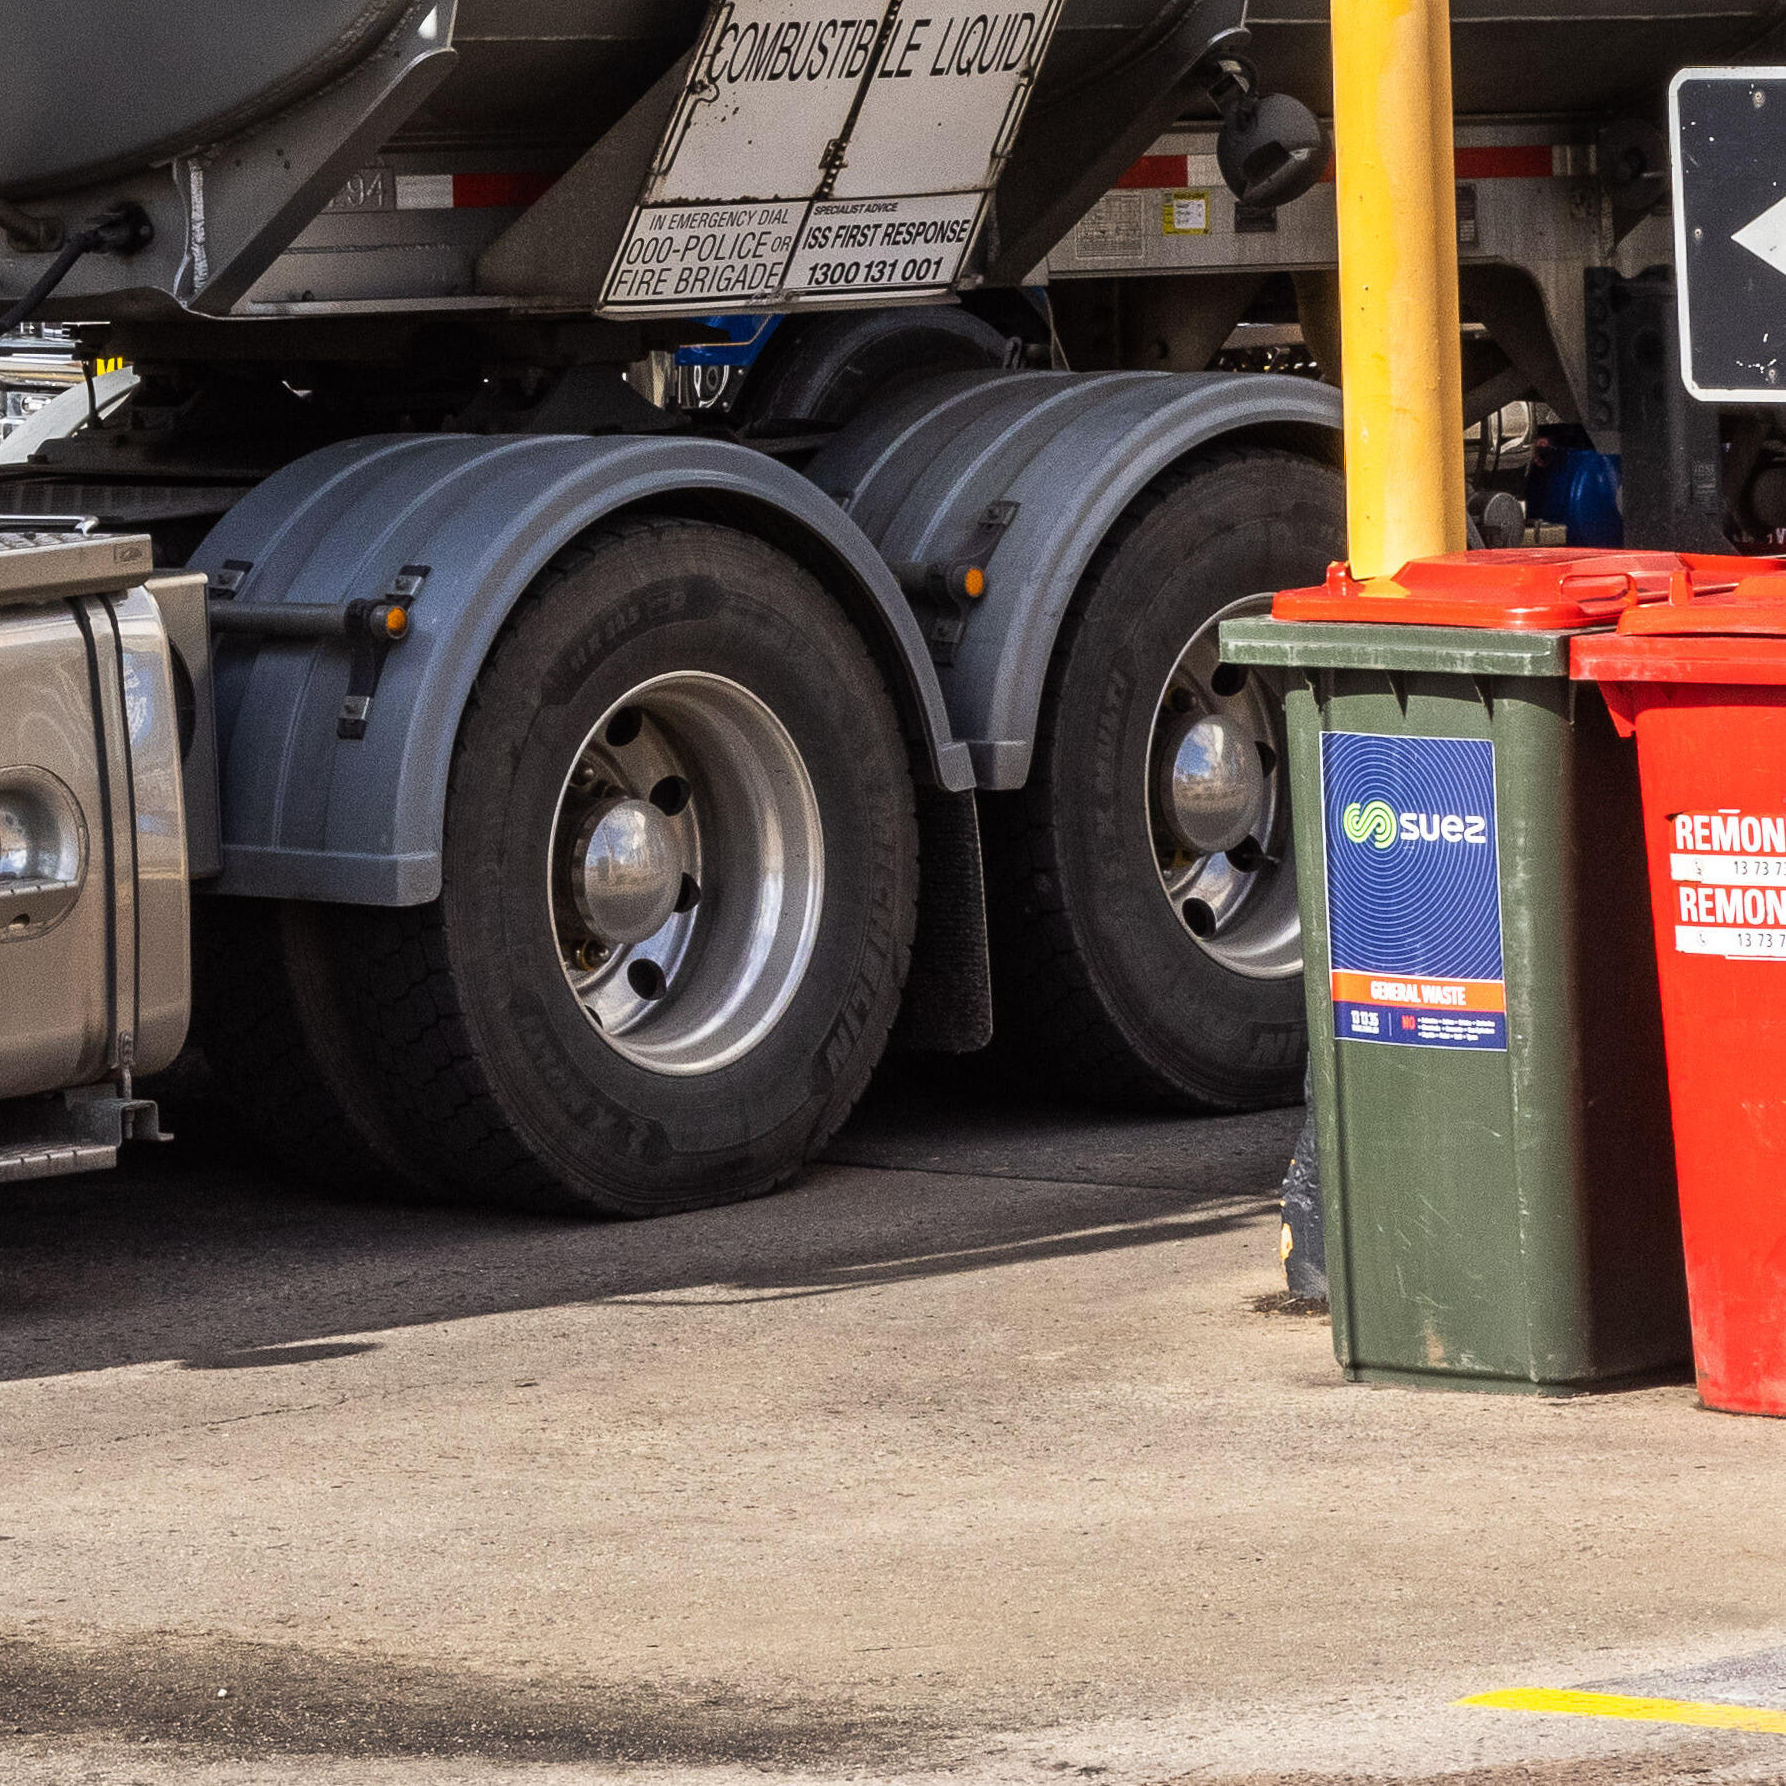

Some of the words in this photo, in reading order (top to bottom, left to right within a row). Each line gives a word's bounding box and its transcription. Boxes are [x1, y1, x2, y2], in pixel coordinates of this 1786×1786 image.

[706, 19, 933, 84] COMBUSTIBLE
[929, 13, 1037, 77] LIQUID
[650, 214, 666, 231] IN
[668, 211, 757, 230] EMERGENCY
[758, 208, 788, 226] DIAL
[814, 204, 866, 215] SPECIALIST
[866, 202, 898, 213] ADVICE
[626, 231, 772, 265] 000-POLICE
[771, 236, 792, 253] OR
[803, 227, 831, 250] ISS
[832, 224, 881, 248] FIRST
[881, 219, 970, 246] RESPONSE
[613, 267, 666, 297] FIRE
[674, 262, 782, 295] BRIGADE
[808, 263, 860, 285] 1300
[862, 260, 896, 283] 131
[901, 257, 944, 281] 001
[1399, 812, 1487, 844] suez
[1675, 814, 1786, 853] REMON
[1734, 861, 1748, 875] 13
[1755, 861, 1769, 876] 73
[1776, 862, 1786, 876] 7
[1679, 887, 1786, 925] REMON
[1738, 933, 1752, 947] 13
[1758, 933, 1773, 948] 73
[1370, 980, 1420, 1003] GENERAL
[1422, 984, 1467, 1006] WASTE
